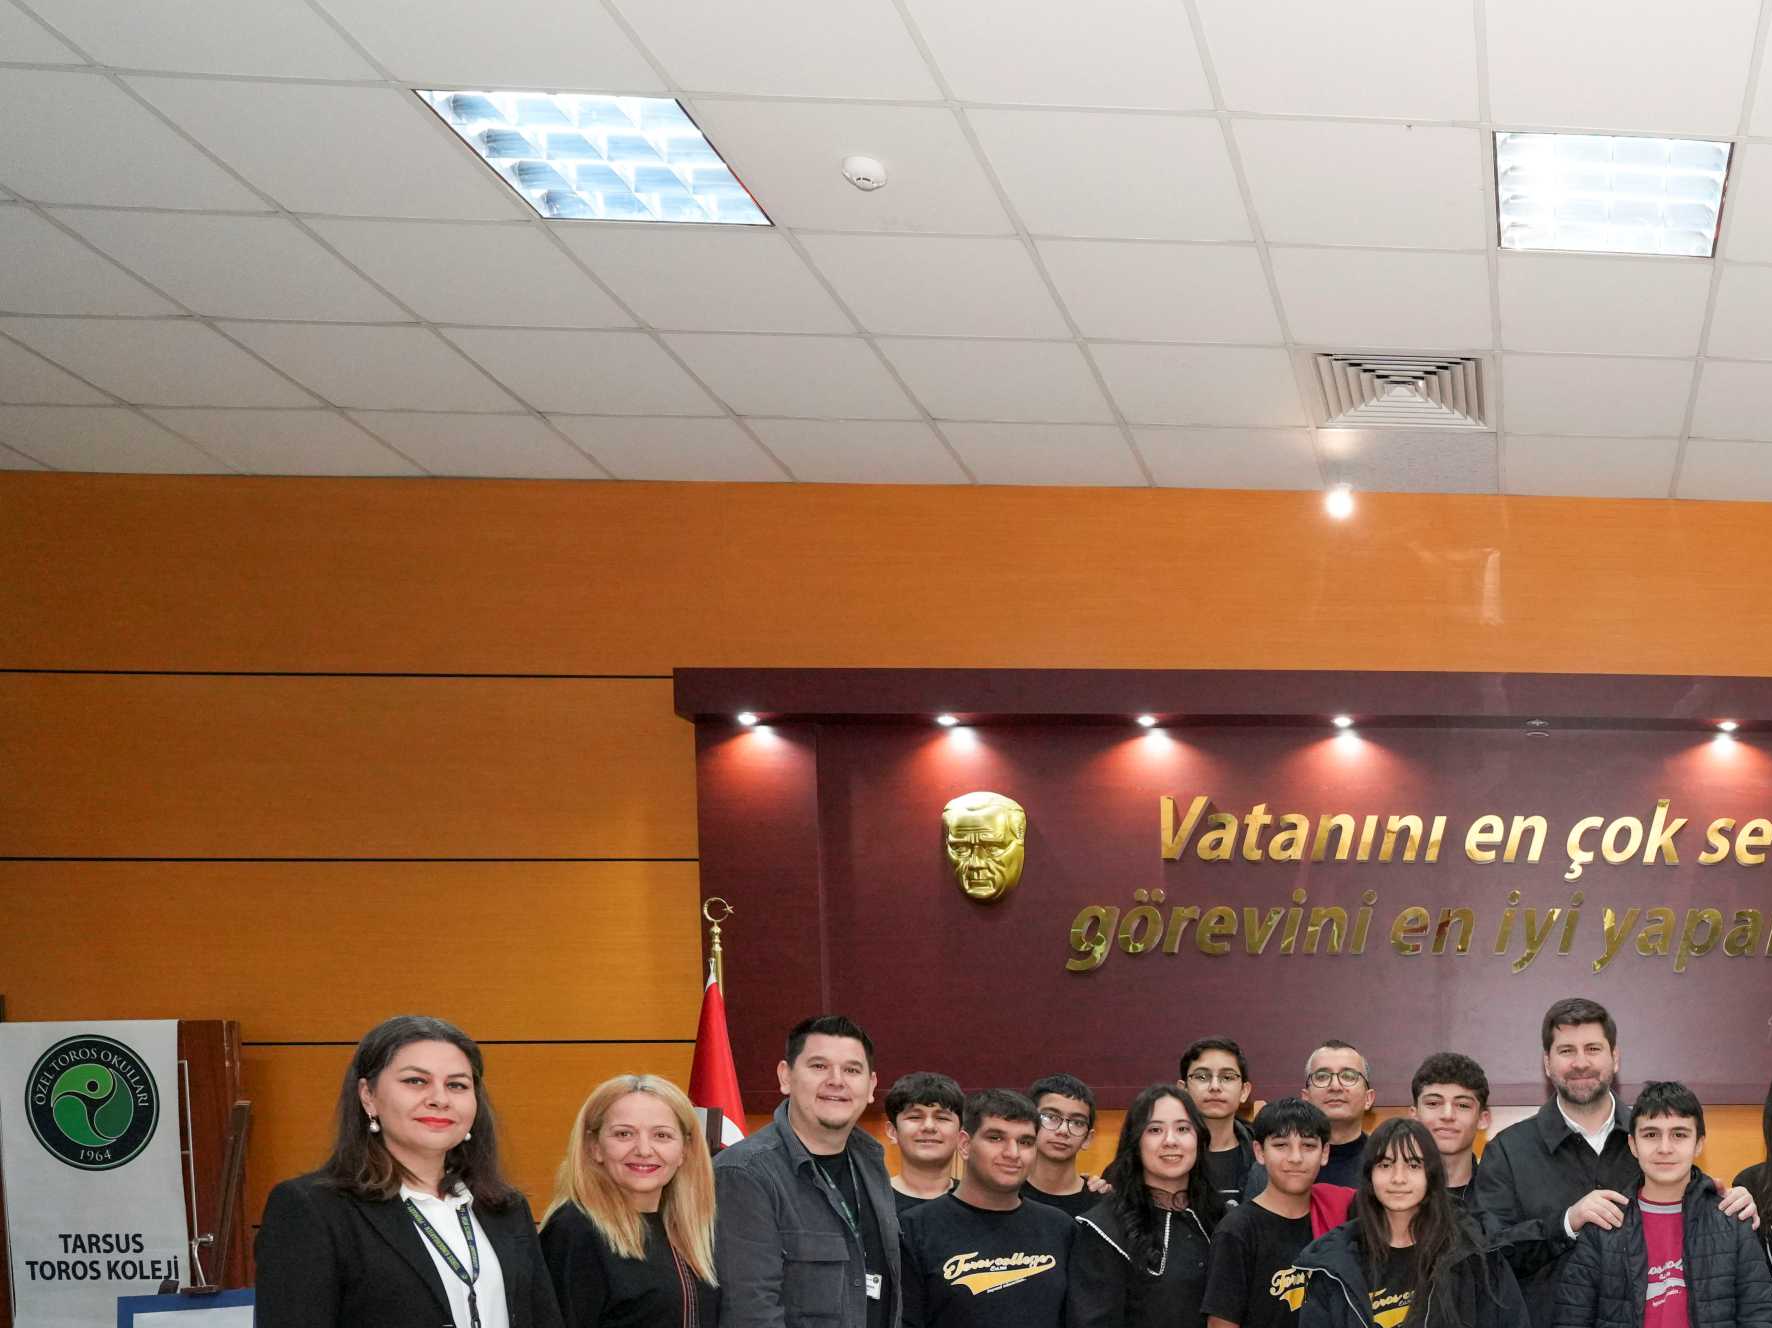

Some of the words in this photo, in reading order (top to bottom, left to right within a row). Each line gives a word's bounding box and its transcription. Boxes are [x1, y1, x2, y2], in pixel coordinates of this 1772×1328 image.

[1159, 795, 1448, 864] Vatanını
[1464, 813, 1549, 864] en
[1563, 799, 1688, 883] çok
[1066, 888, 1378, 973] görevini
[1390, 907, 1476, 956] en
[1494, 889, 1585, 974] iyi
[52, 1048, 98, 1071] TOROS
[101, 1051, 150, 1107] OKULLARI
[79, 1149, 112, 1162] 1964
[58, 1233, 145, 1254] TARSUS
[25, 1260, 101, 1281] TOROS
[107, 1255, 180, 1281] KOLEJİ
